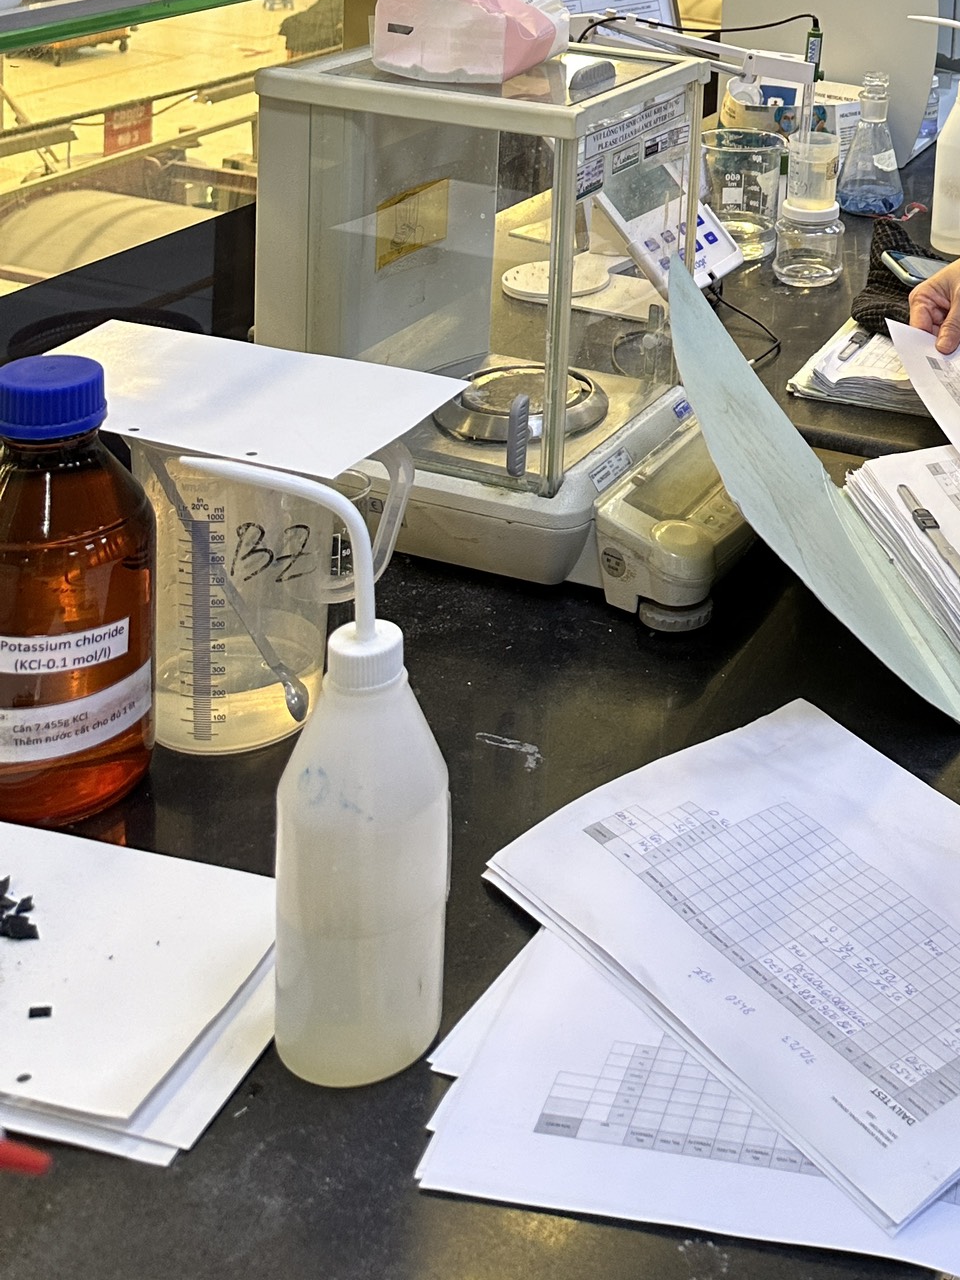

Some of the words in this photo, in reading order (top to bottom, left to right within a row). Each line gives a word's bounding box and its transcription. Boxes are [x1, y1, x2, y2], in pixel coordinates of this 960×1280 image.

[0, 640, 71, 652] Potassium
[75, 626, 125, 648] chloride
[869, 1087, 892, 1106] TEST
[888, 1104, 916, 1127] DAILY
